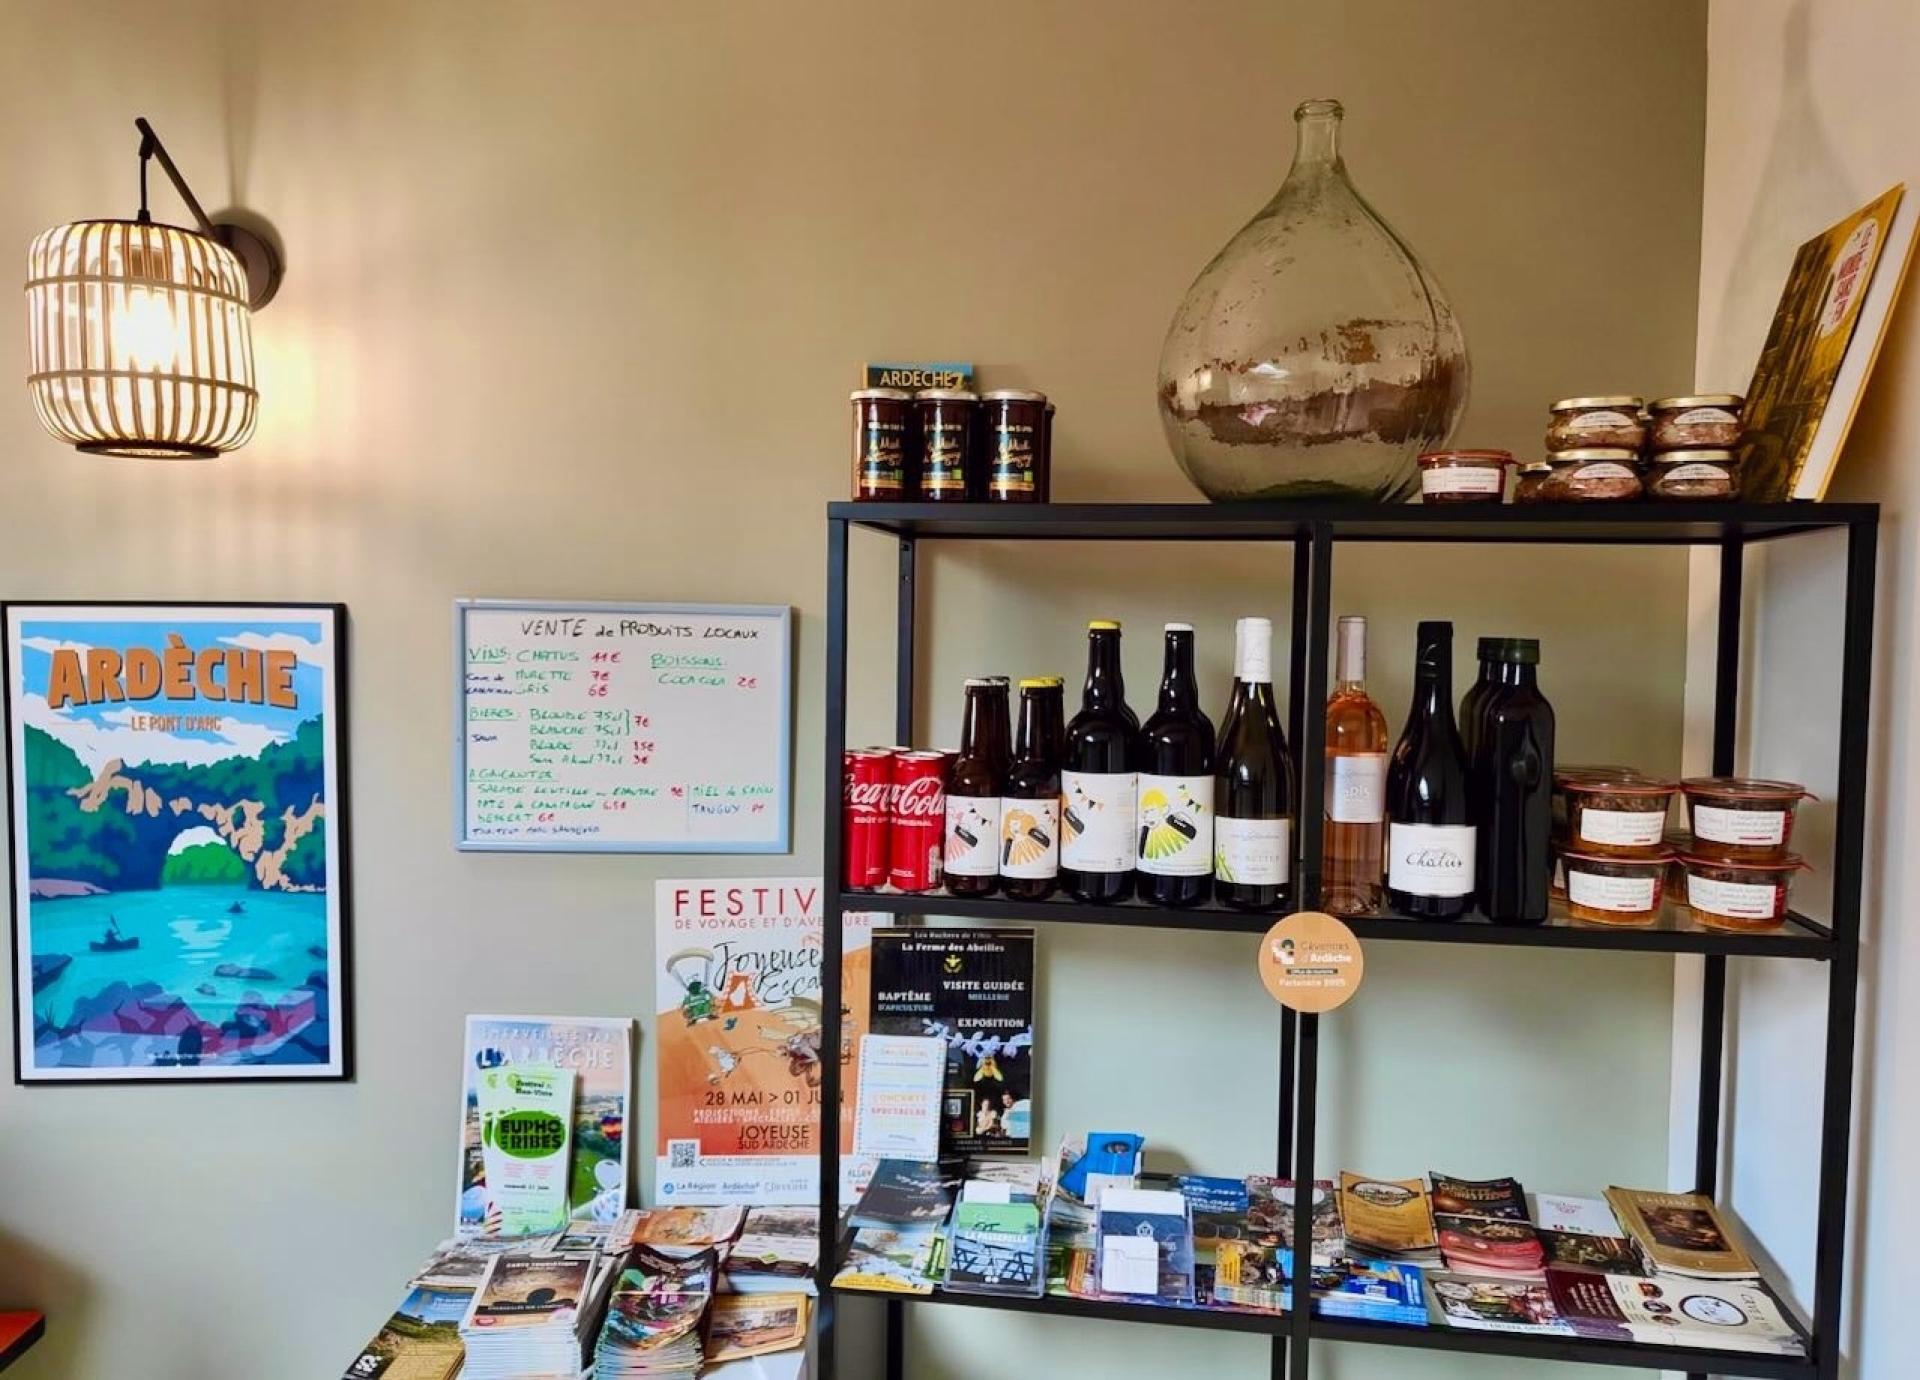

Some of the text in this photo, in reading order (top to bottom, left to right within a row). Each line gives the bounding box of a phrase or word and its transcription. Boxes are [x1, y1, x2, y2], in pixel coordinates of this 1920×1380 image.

[521, 619, 587, 637] VENTE
[595, 622, 615, 637] de
[703, 626, 759, 639] LOCAUX
[516, 650, 579, 662] CHATUS
[47, 633, 298, 710] ARDÈCHE
[590, 670, 611, 681] 7€
[737, 676, 757, 689] 2€
[587, 684, 609, 696] 6€
[131, 716, 222, 731] LE PONT D'ARC
[634, 715, 650, 728] 7€
[675, 888, 817, 916] FESTIV
[675, 916, 870, 929] DE VOYAGE ET D'AVEURE
[901, 942, 1005, 952] La Ferme des Abeilles
[713, 941, 822, 991] Joyeuse
[943, 979, 1025, 991] VISITE GUIDÉE
[877, 989, 932, 1001] BAPTÊME
[957, 1018, 1025, 1028] EXPOSITION
[706, 1091, 725, 1105] 28
[732, 1091, 762, 1105] MAI
[784, 1091, 800, 1104] 01
[500, 1119, 560, 1133] EUPHO
[738, 1125, 810, 1139] JOYEUSE
[738, 1140, 759, 1150] SUD
